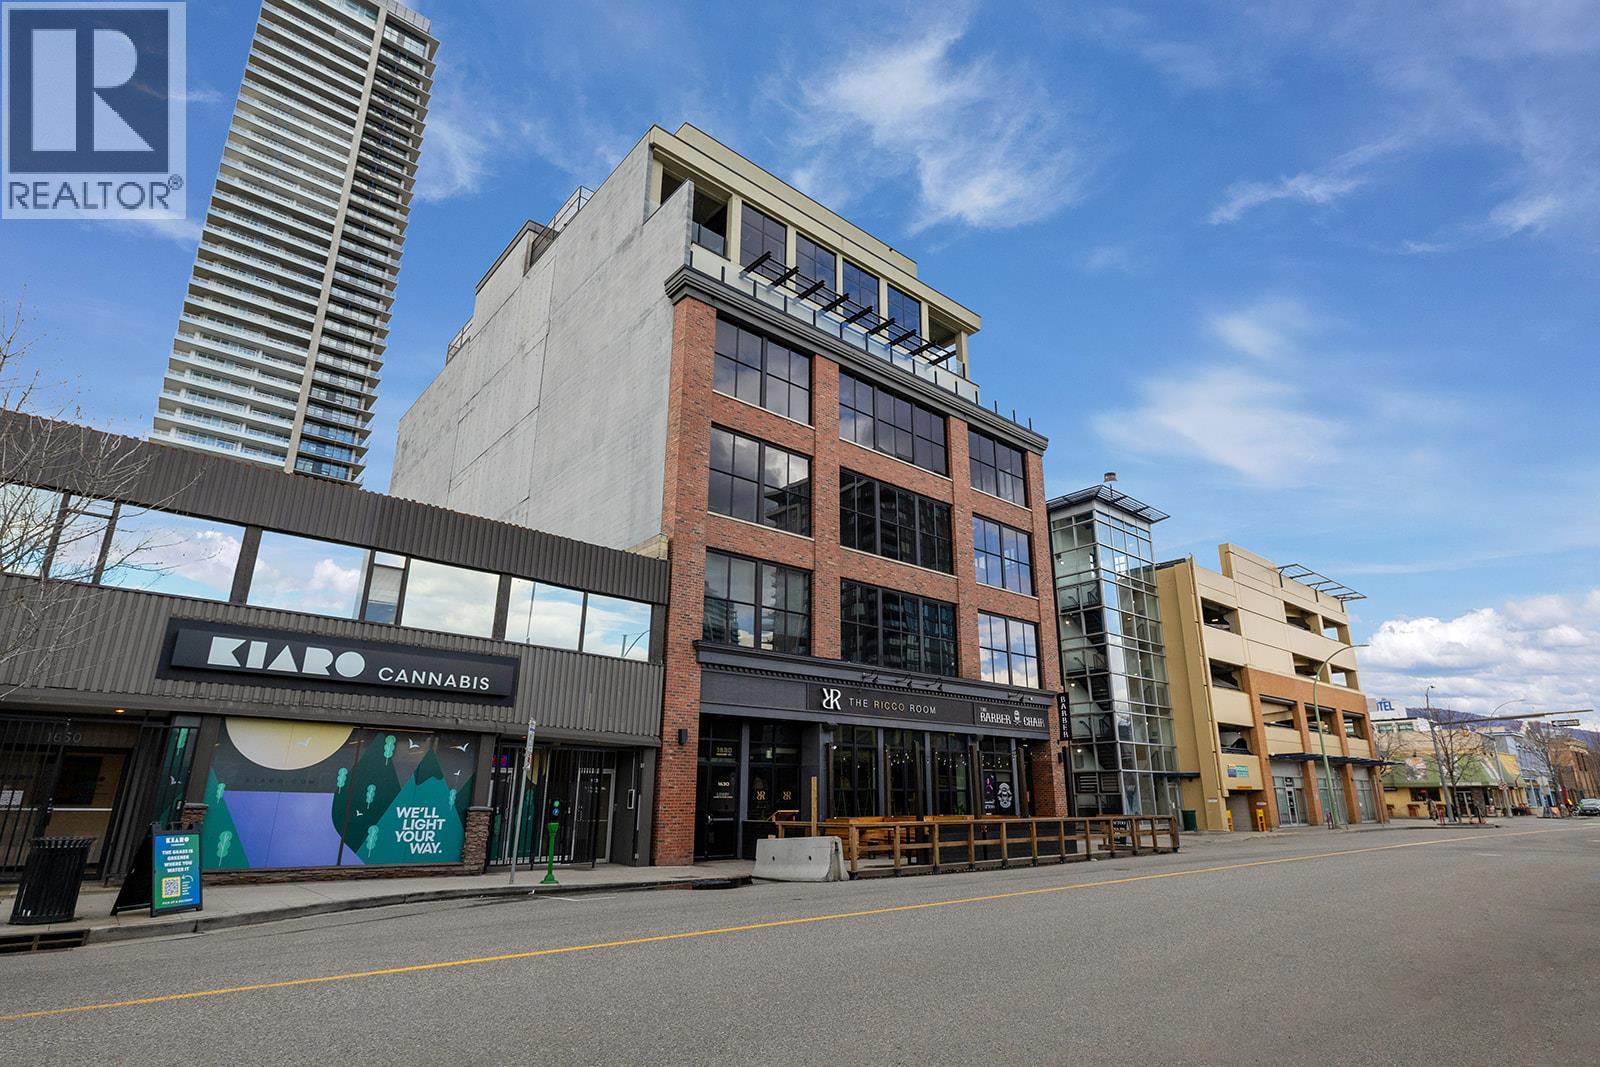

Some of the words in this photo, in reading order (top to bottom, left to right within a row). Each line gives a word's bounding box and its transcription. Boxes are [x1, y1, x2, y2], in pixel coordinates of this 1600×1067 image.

[207, 636, 365, 678] KIARO
[378, 667, 490, 691] CANNABIS
[849, 698, 868, 708] THE
[873, 700, 905, 712] RICCO
[909, 703, 937, 714] ROOM
[980, 712, 1012, 725] BARBER
[1023, 716, 1045, 728] CHAIR
[1060, 696, 1069, 738] BARBER
[396, 806, 440, 819] WE'LL
[402, 818, 446, 830] LIGHT
[395, 830, 436, 843] YOUR
[409, 842, 443, 855] WAY.
